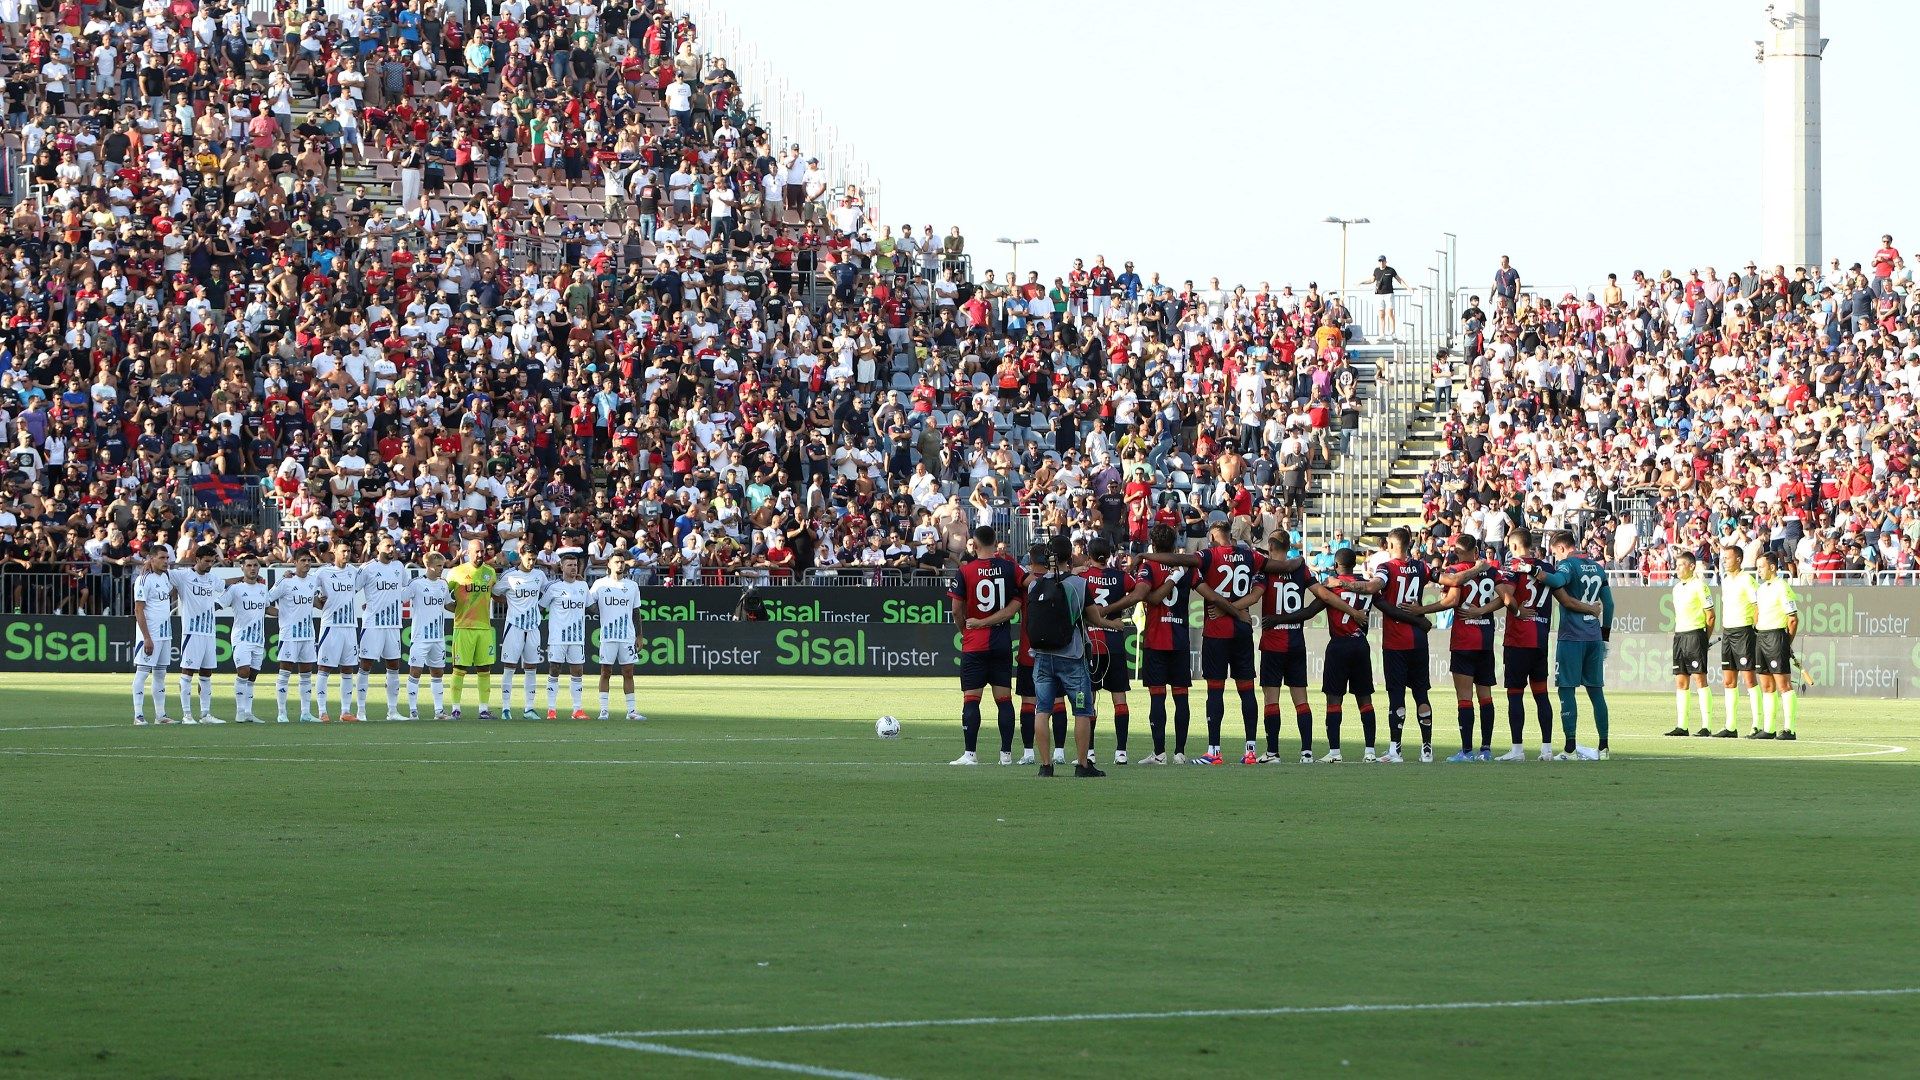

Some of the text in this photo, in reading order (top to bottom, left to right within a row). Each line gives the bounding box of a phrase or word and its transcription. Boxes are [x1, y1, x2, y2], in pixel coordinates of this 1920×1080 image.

[977, 567, 1002, 577] PICCOLI
[1088, 575, 1118, 586] AUGELLO
[1213, 564, 1251, 599] 26
[192, 585, 213, 597] Uber
[376, 581, 399, 591] Uber
[465, 583, 490, 593] Uber
[515, 588, 539, 599] Uber
[975, 578, 1007, 613] 91
[1273, 581, 1302, 615] 16
[1396, 575, 1420, 609] 14
[1460, 577, 1495, 610] 28
[561, 599, 584, 610] Uber
[605, 596, 630, 607] Uber
[882, 599, 943, 624] Sisal
[1854, 611, 1910, 636] Tipster
[5, 621, 107, 663] Sisal
[775, 628, 866, 666] Sisal
[867, 646, 939, 671] Tipster
[687, 644, 762, 670] Tipster
[1837, 662, 1899, 694] Tipster
